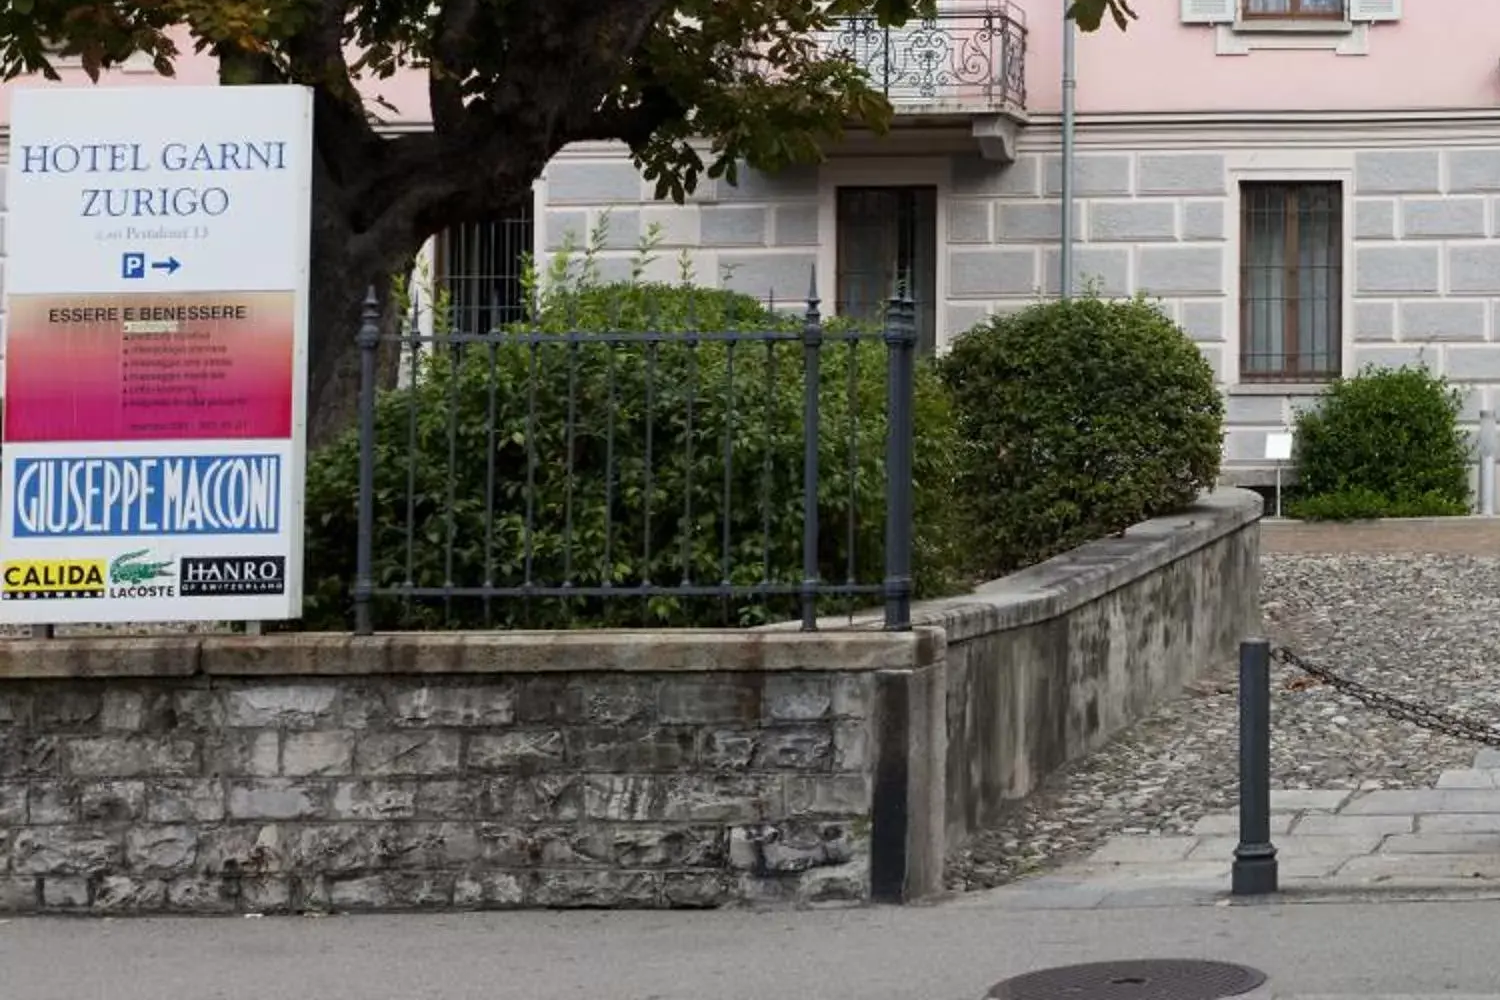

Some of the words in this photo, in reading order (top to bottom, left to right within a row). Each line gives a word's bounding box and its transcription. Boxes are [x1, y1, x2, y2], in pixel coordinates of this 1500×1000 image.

[20, 143, 150, 174] HOTEL
[161, 141, 288, 172] GARNI
[80, 187, 230, 218] ZURIGO
[125, 255, 142, 276] P
[49, 307, 118, 323] ESSERE
[123, 307, 135, 321] E
[139, 305, 248, 321] BENESSERE
[17, 459, 158, 533] GIUSEPPE
[163, 457, 277, 531] MACCONI
[3, 565, 104, 587] CALIDA
[187, 561, 278, 581] HANRO
[109, 584, 175, 599] LACOSTE
